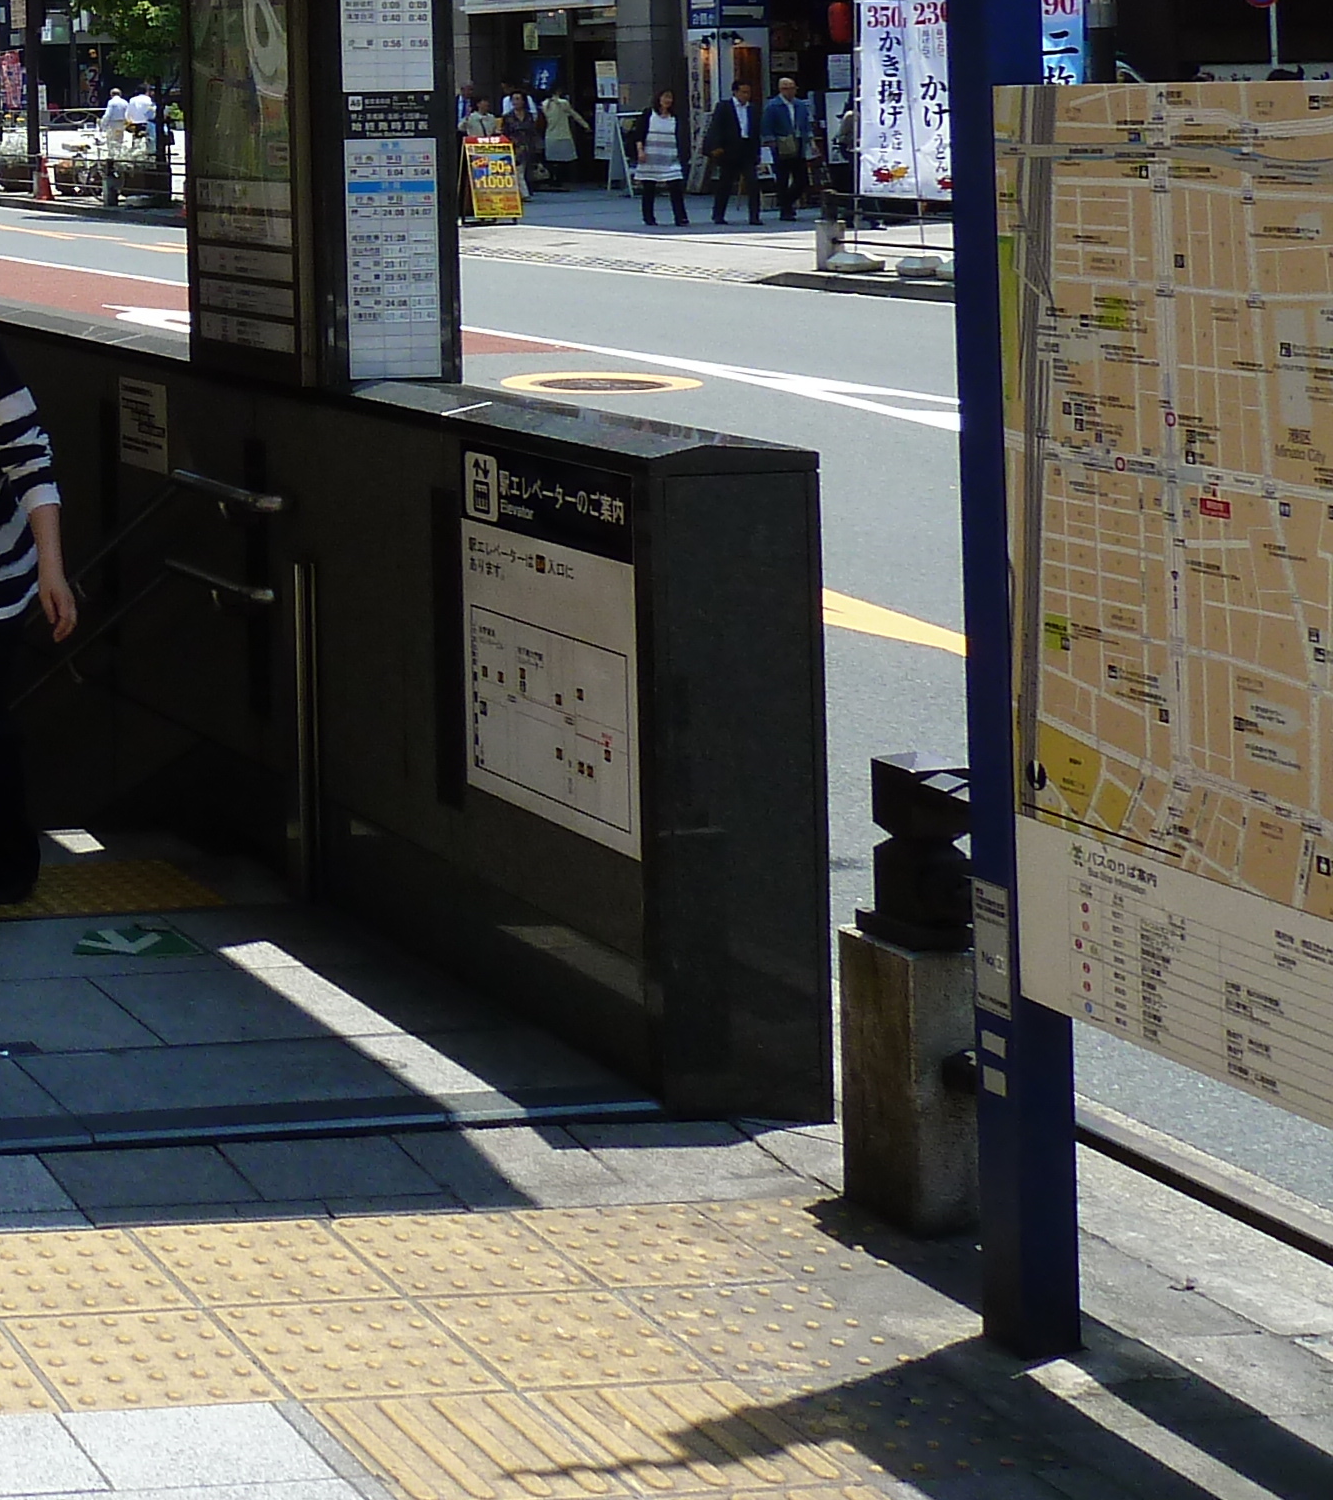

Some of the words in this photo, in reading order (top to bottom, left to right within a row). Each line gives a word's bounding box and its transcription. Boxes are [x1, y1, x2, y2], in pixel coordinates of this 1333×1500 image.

[877, 30, 903, 128] かき揚げ
[919, 74, 951, 132] かけ
[499, 470, 625, 526] 駅エレベーターのご案内
[499, 498, 535, 520] Elevator
[1087, 852, 1157, 888] バスのりば案内
